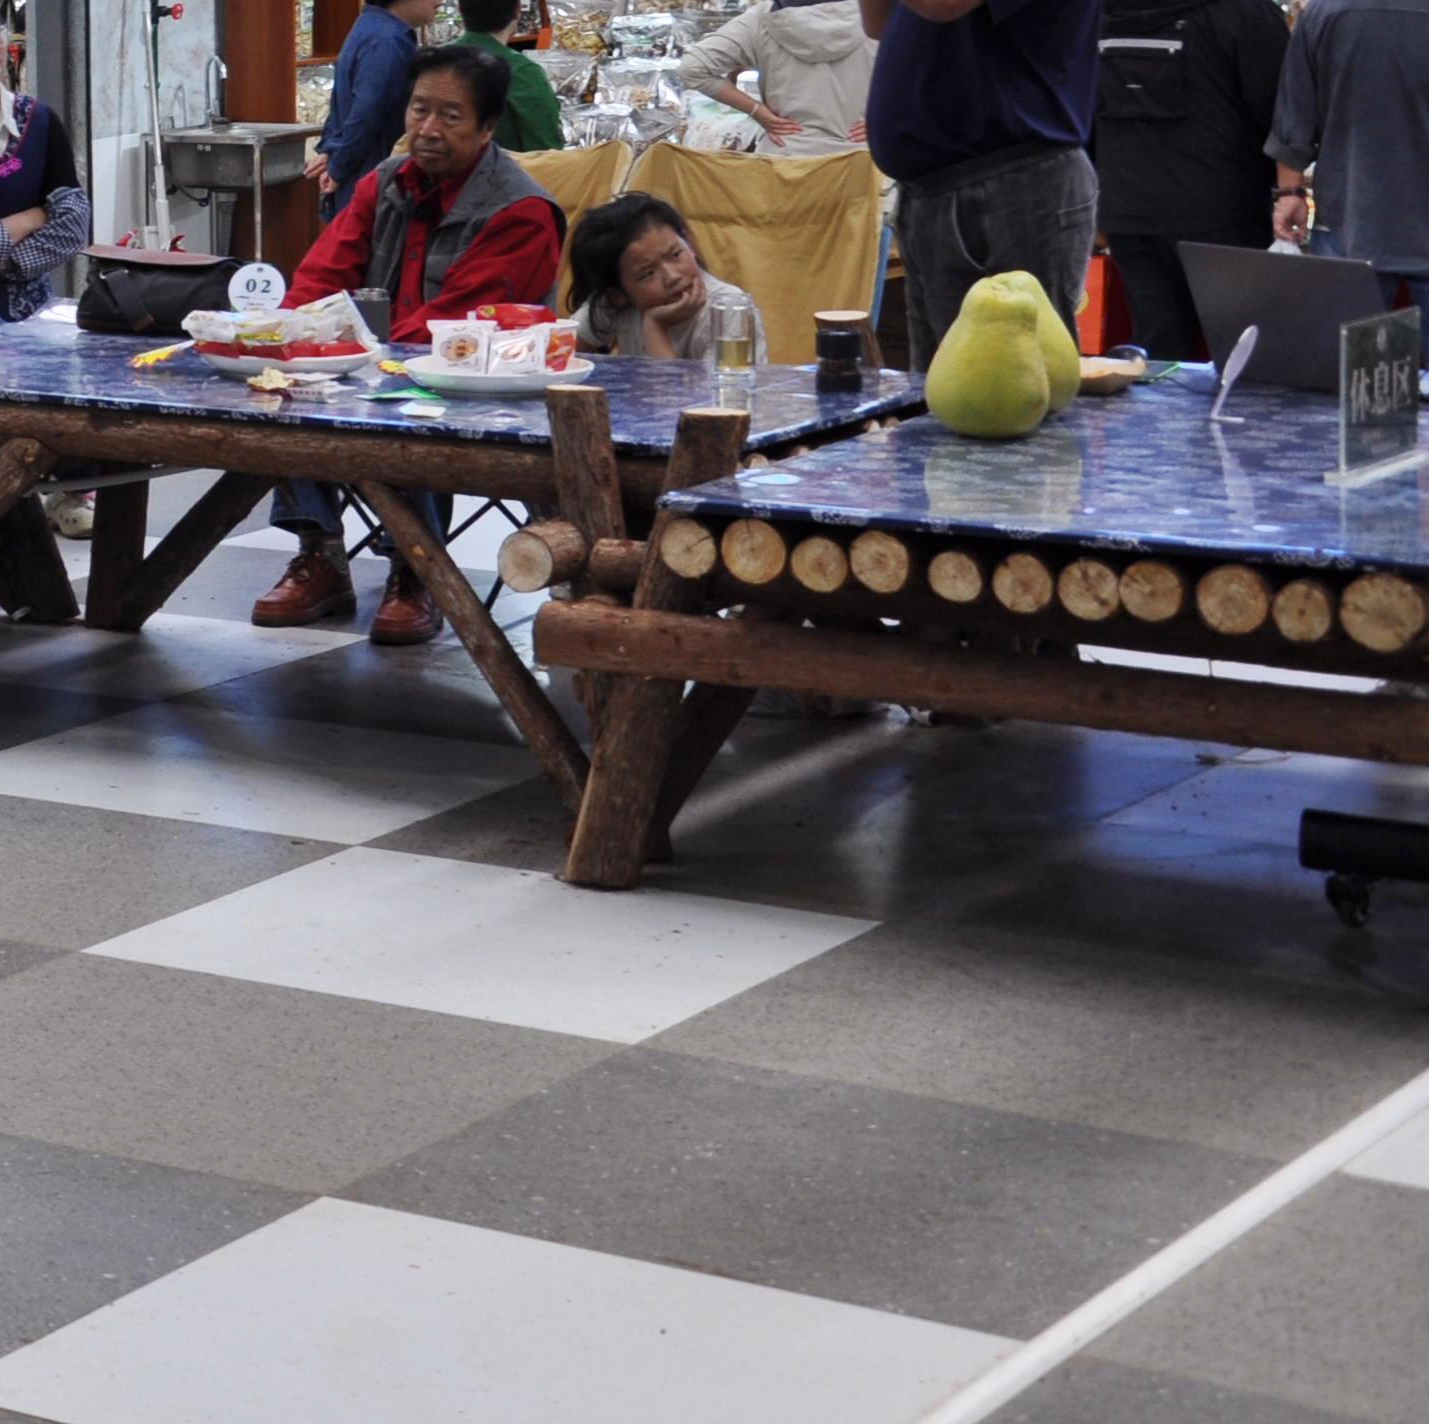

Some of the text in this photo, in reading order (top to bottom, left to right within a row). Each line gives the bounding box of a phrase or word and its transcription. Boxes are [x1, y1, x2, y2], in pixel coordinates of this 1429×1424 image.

[245, 278, 272, 294] 02
[1350, 354, 1412, 424] 休息区
